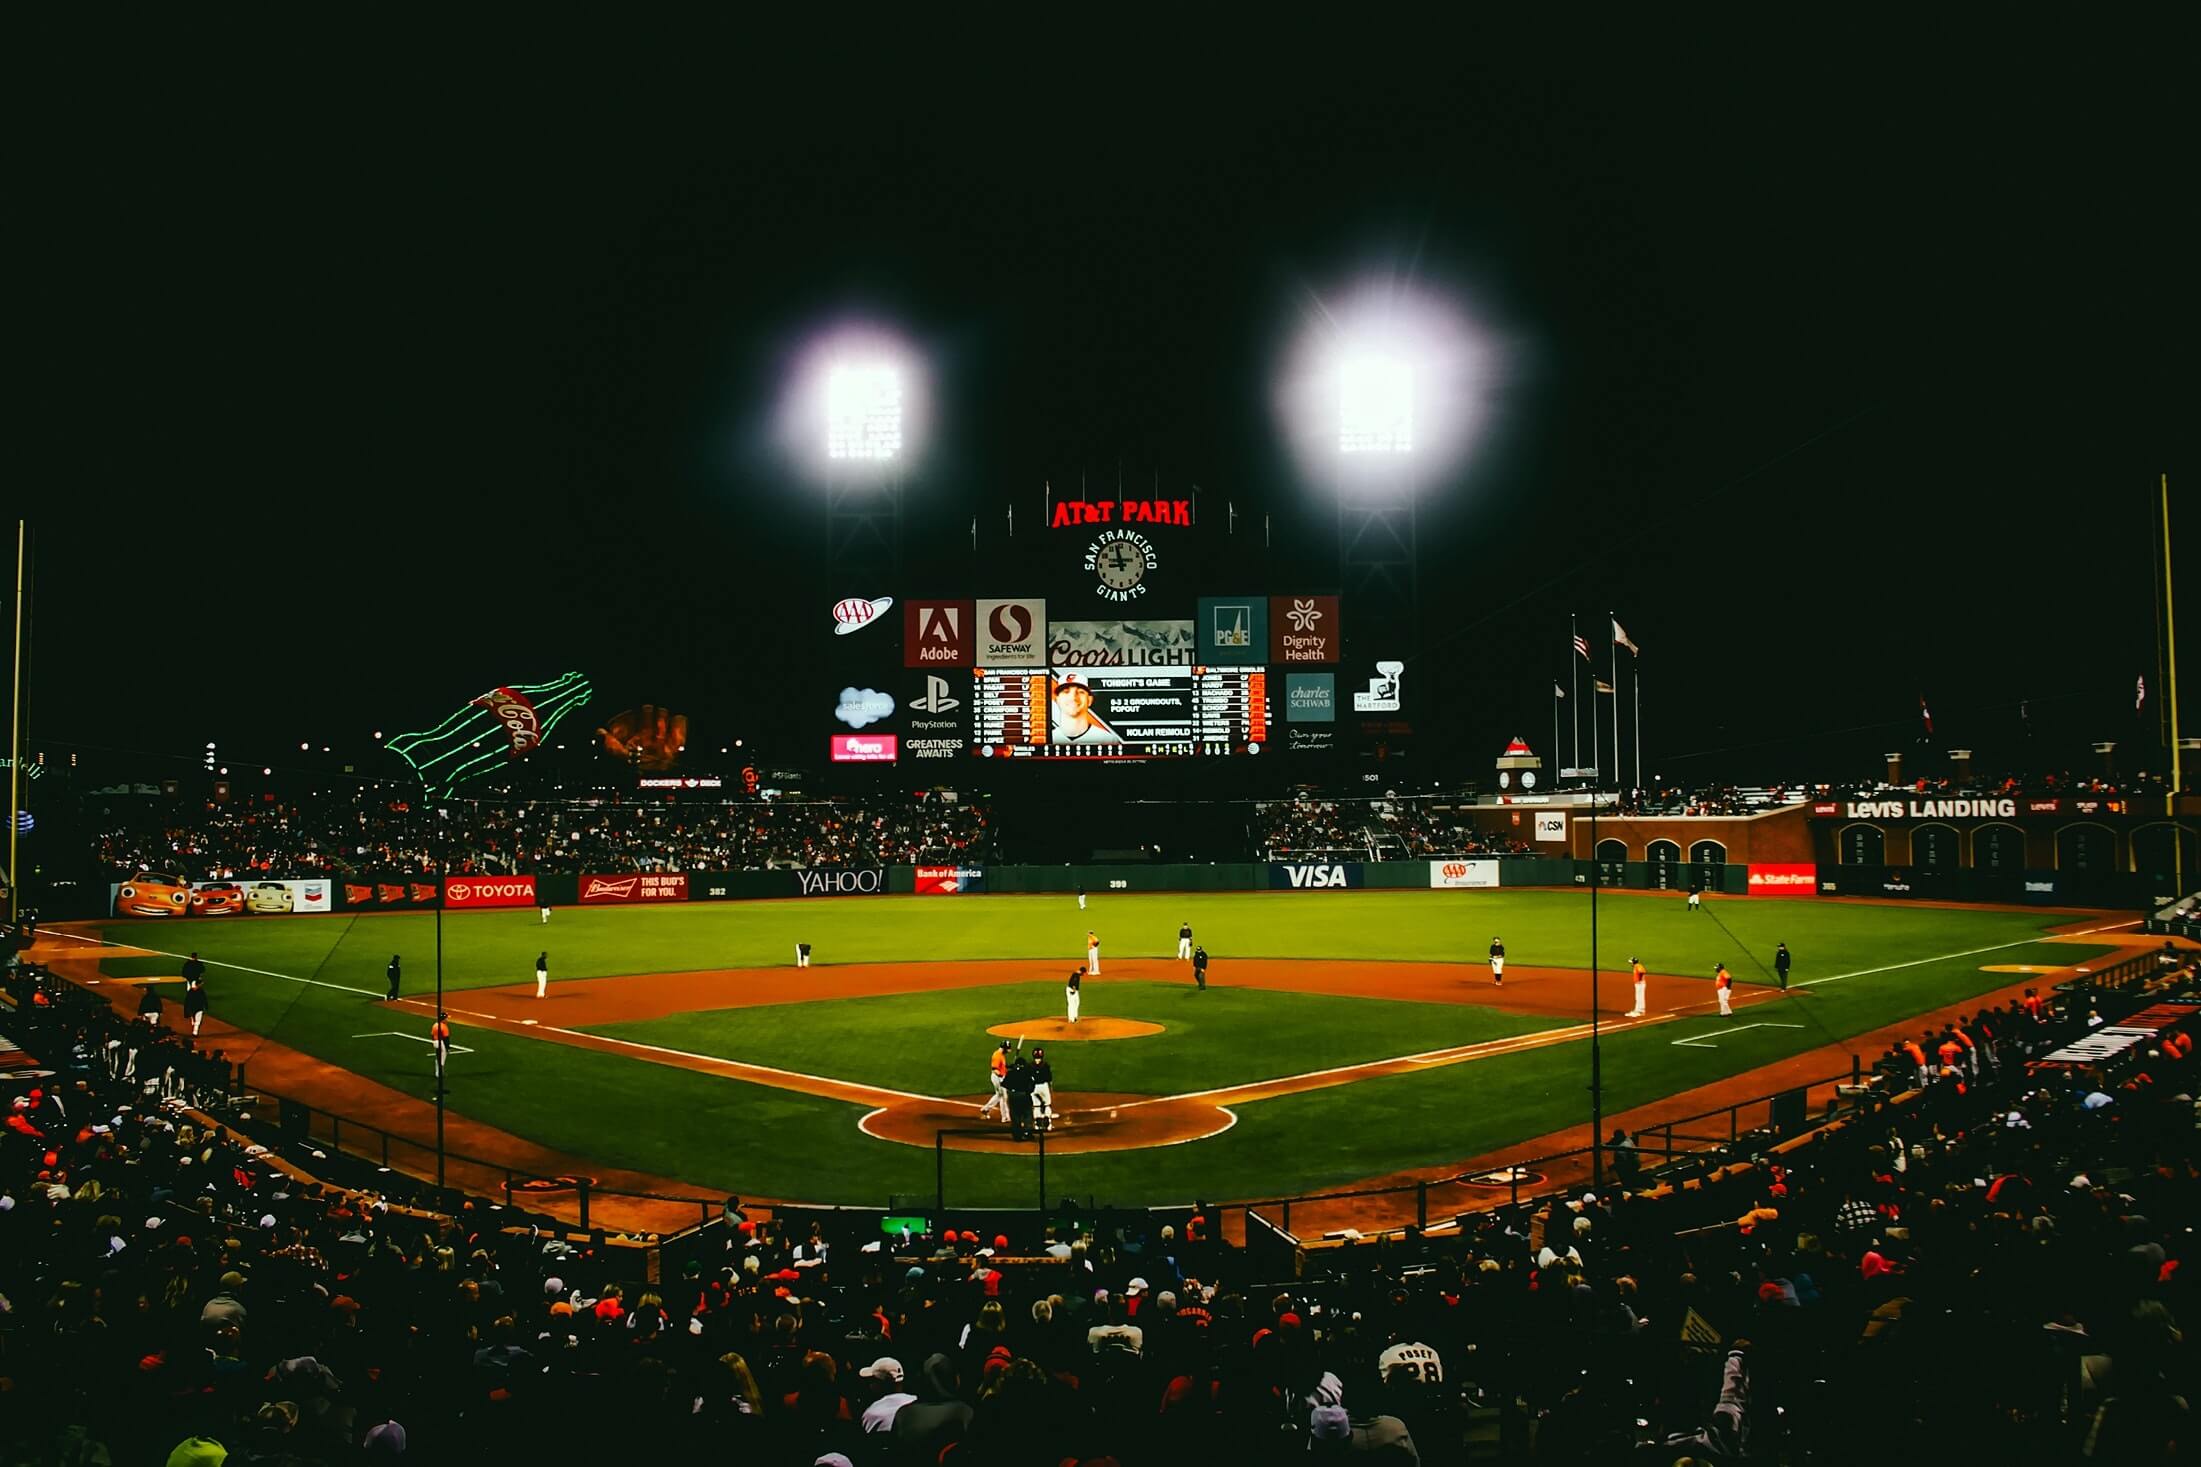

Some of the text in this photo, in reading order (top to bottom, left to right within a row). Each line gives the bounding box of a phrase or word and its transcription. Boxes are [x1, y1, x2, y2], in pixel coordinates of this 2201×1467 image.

[1052, 500, 1190, 528] AT&T PARK
[1084, 528, 1157, 571] SAN FRANCISCO
[1096, 583, 1146, 601] GIANTS
[836, 599, 873, 624] AAA
[1216, 630, 1249, 645] PG&E
[1283, 635, 1326, 649] Dignity
[919, 647, 959, 660] Adobe
[989, 644, 1032, 653] SAFEWAY
[1050, 639, 1196, 666] Coors LIGHT
[1286, 649, 1325, 660] Health
[1101, 678, 1171, 687] TONIGHT'S GAME
[1291, 686, 1330, 698] charles
[842, 700, 887, 712] salesfor
[1291, 699, 1330, 708] SCHWAB
[912, 721, 957, 731] PlayStation
[1127, 728, 1154, 736] NOLAN
[906, 739, 963, 749] GREATNESS
[916, 748, 954, 758] AWAITS
[1910, 799, 2016, 817] LANDING
[917, 869, 982, 878] Bank of America
[1282, 864, 1347, 888] VISA
[1443, 863, 1466, 878] AAA
[641, 876, 685, 887] THIS BUD'S
[797, 869, 884, 895] YAHOO!
[474, 884, 535, 898] TOYOTA
[641, 887, 677, 897] FOR YOU.
[1398, 1349, 1433, 1361] POSEY
